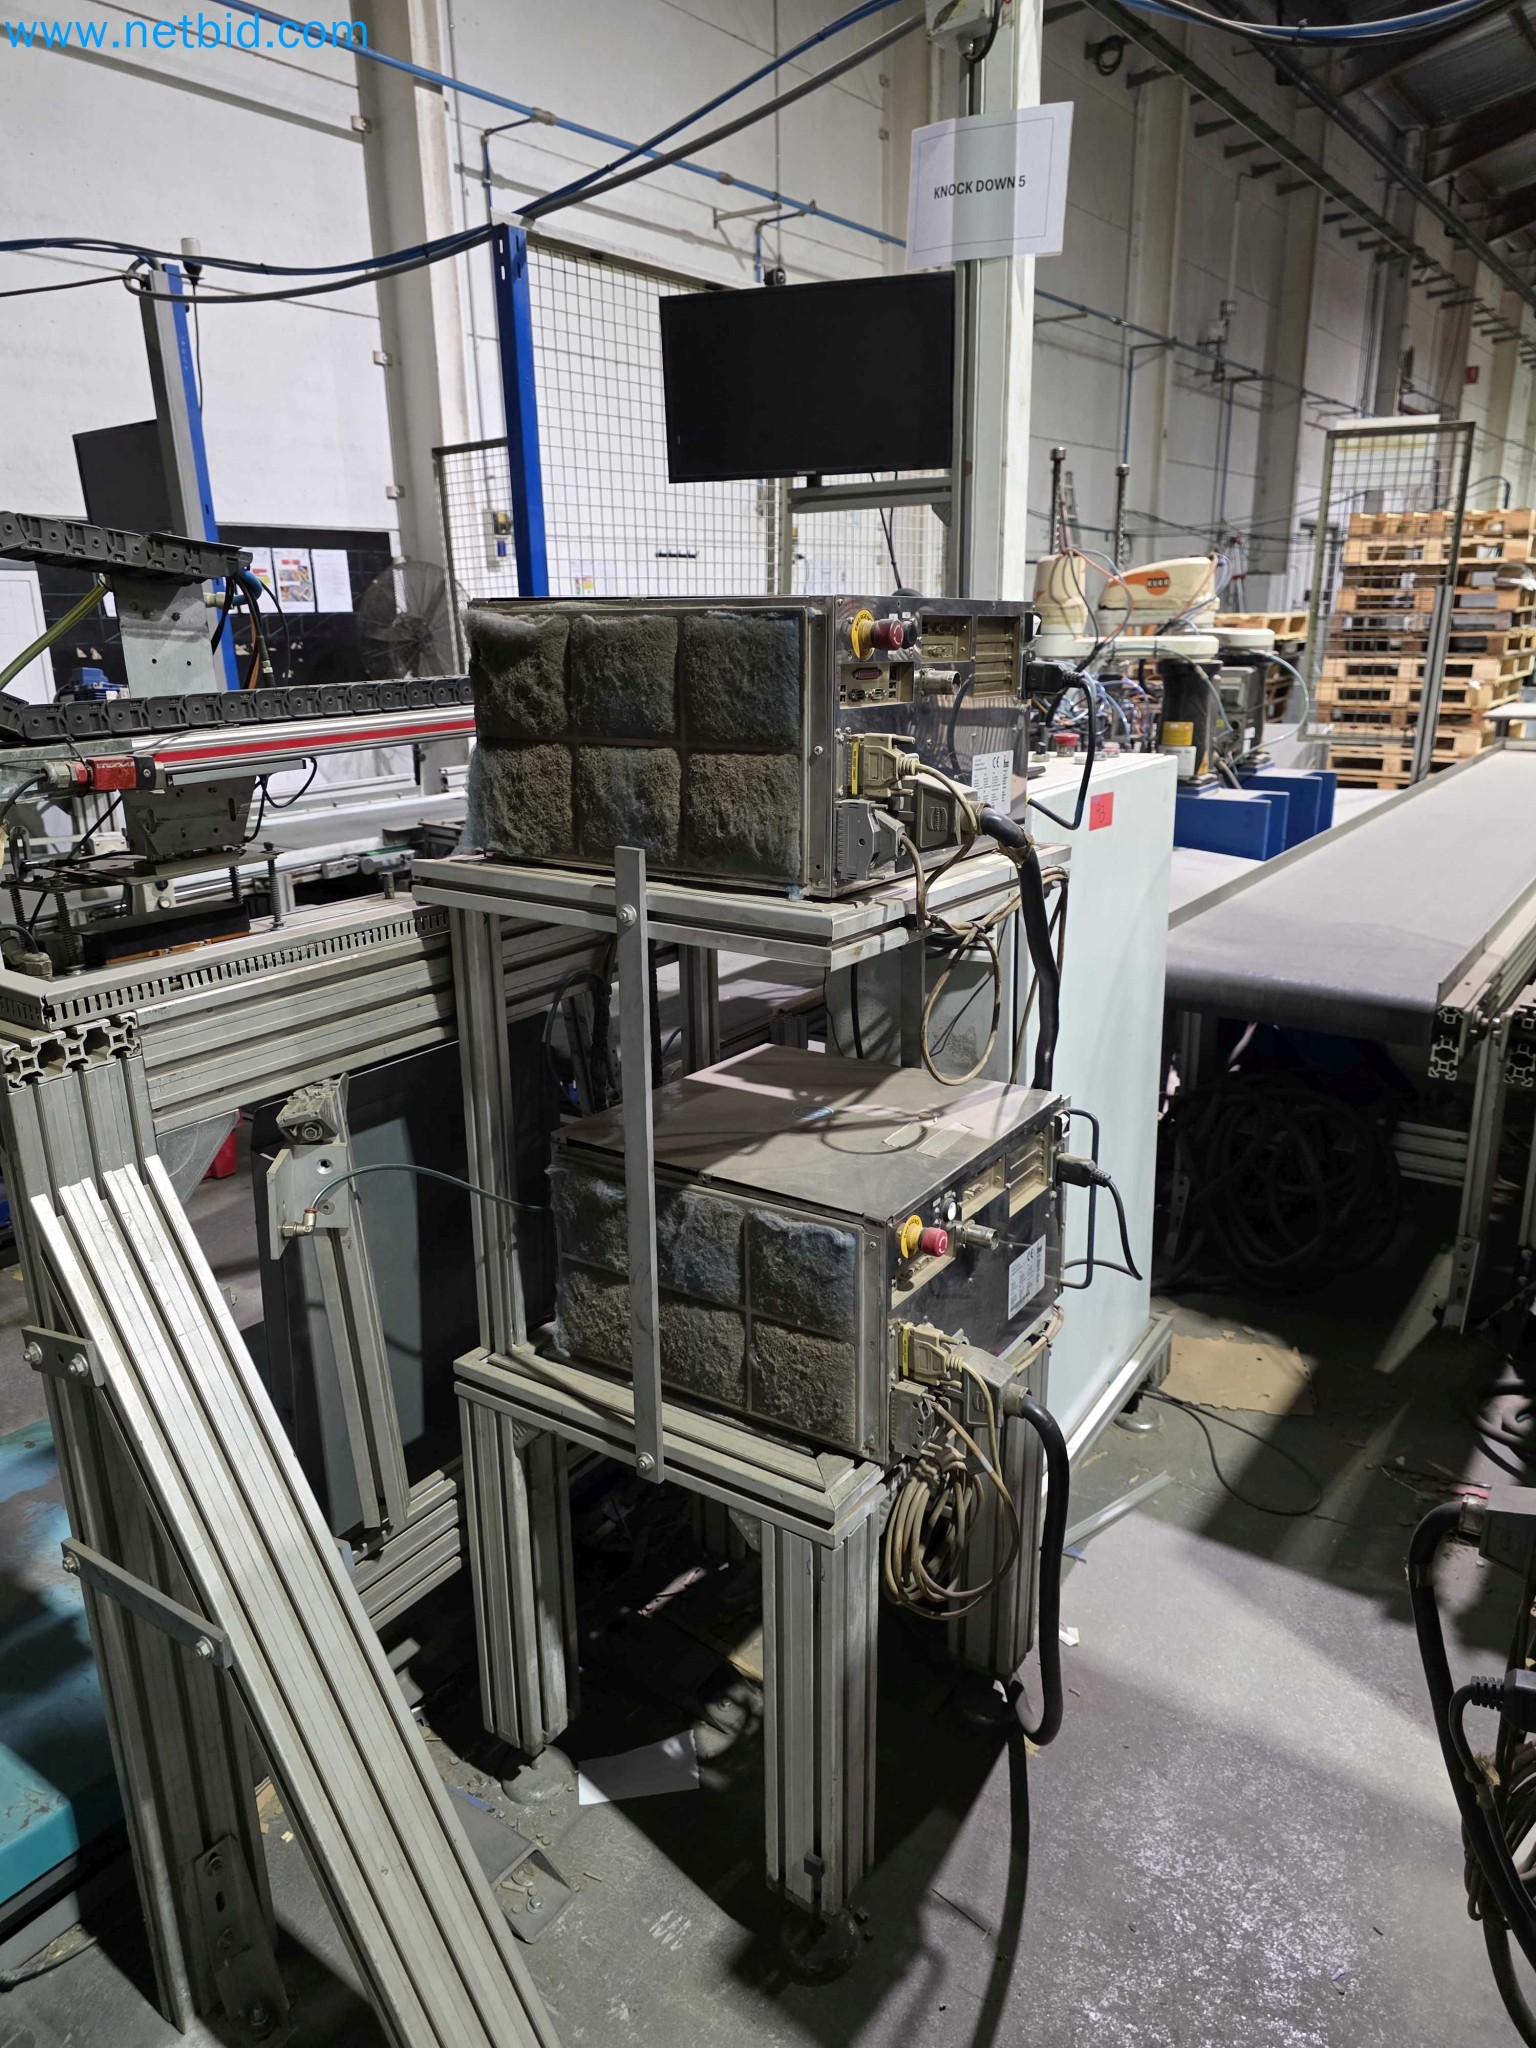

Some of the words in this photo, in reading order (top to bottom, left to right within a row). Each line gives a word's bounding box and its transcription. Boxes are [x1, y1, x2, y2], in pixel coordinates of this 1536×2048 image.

[933, 181, 974, 200] KNOCK
[975, 175, 1016, 193] DOWN
[1018, 175, 1026, 188] 5
